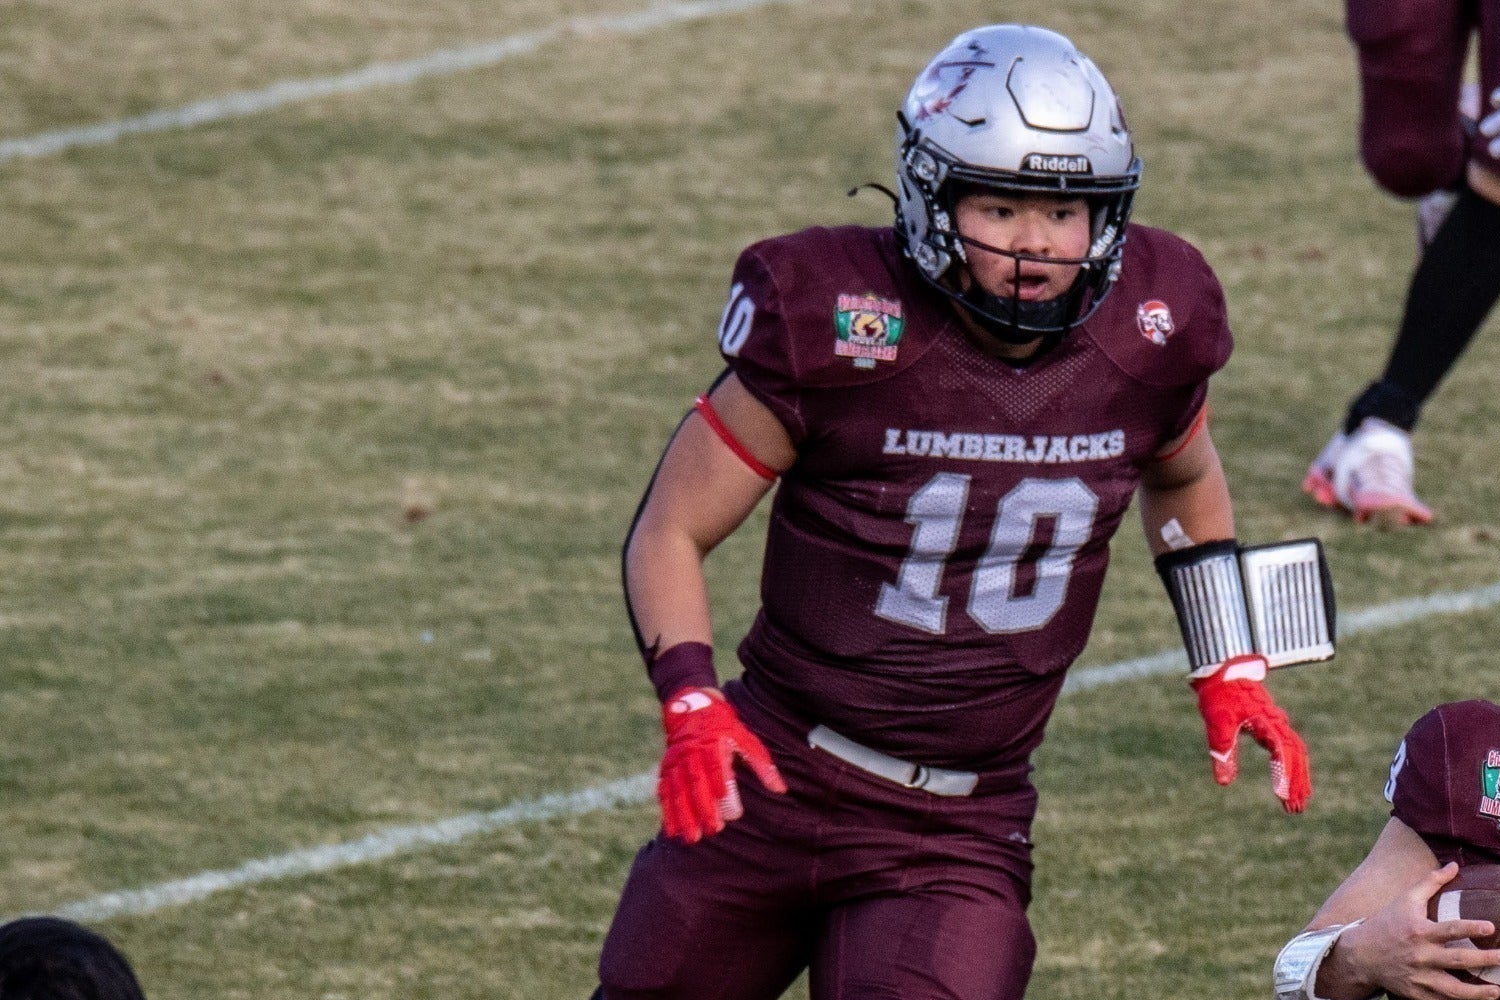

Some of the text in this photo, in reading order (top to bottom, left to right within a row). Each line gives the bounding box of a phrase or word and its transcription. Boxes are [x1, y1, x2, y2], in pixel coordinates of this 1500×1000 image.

[1030, 155, 1088, 172] Riddell
[883, 428, 1125, 463] LUMBERJACKS
[875, 472, 1099, 634] 10
